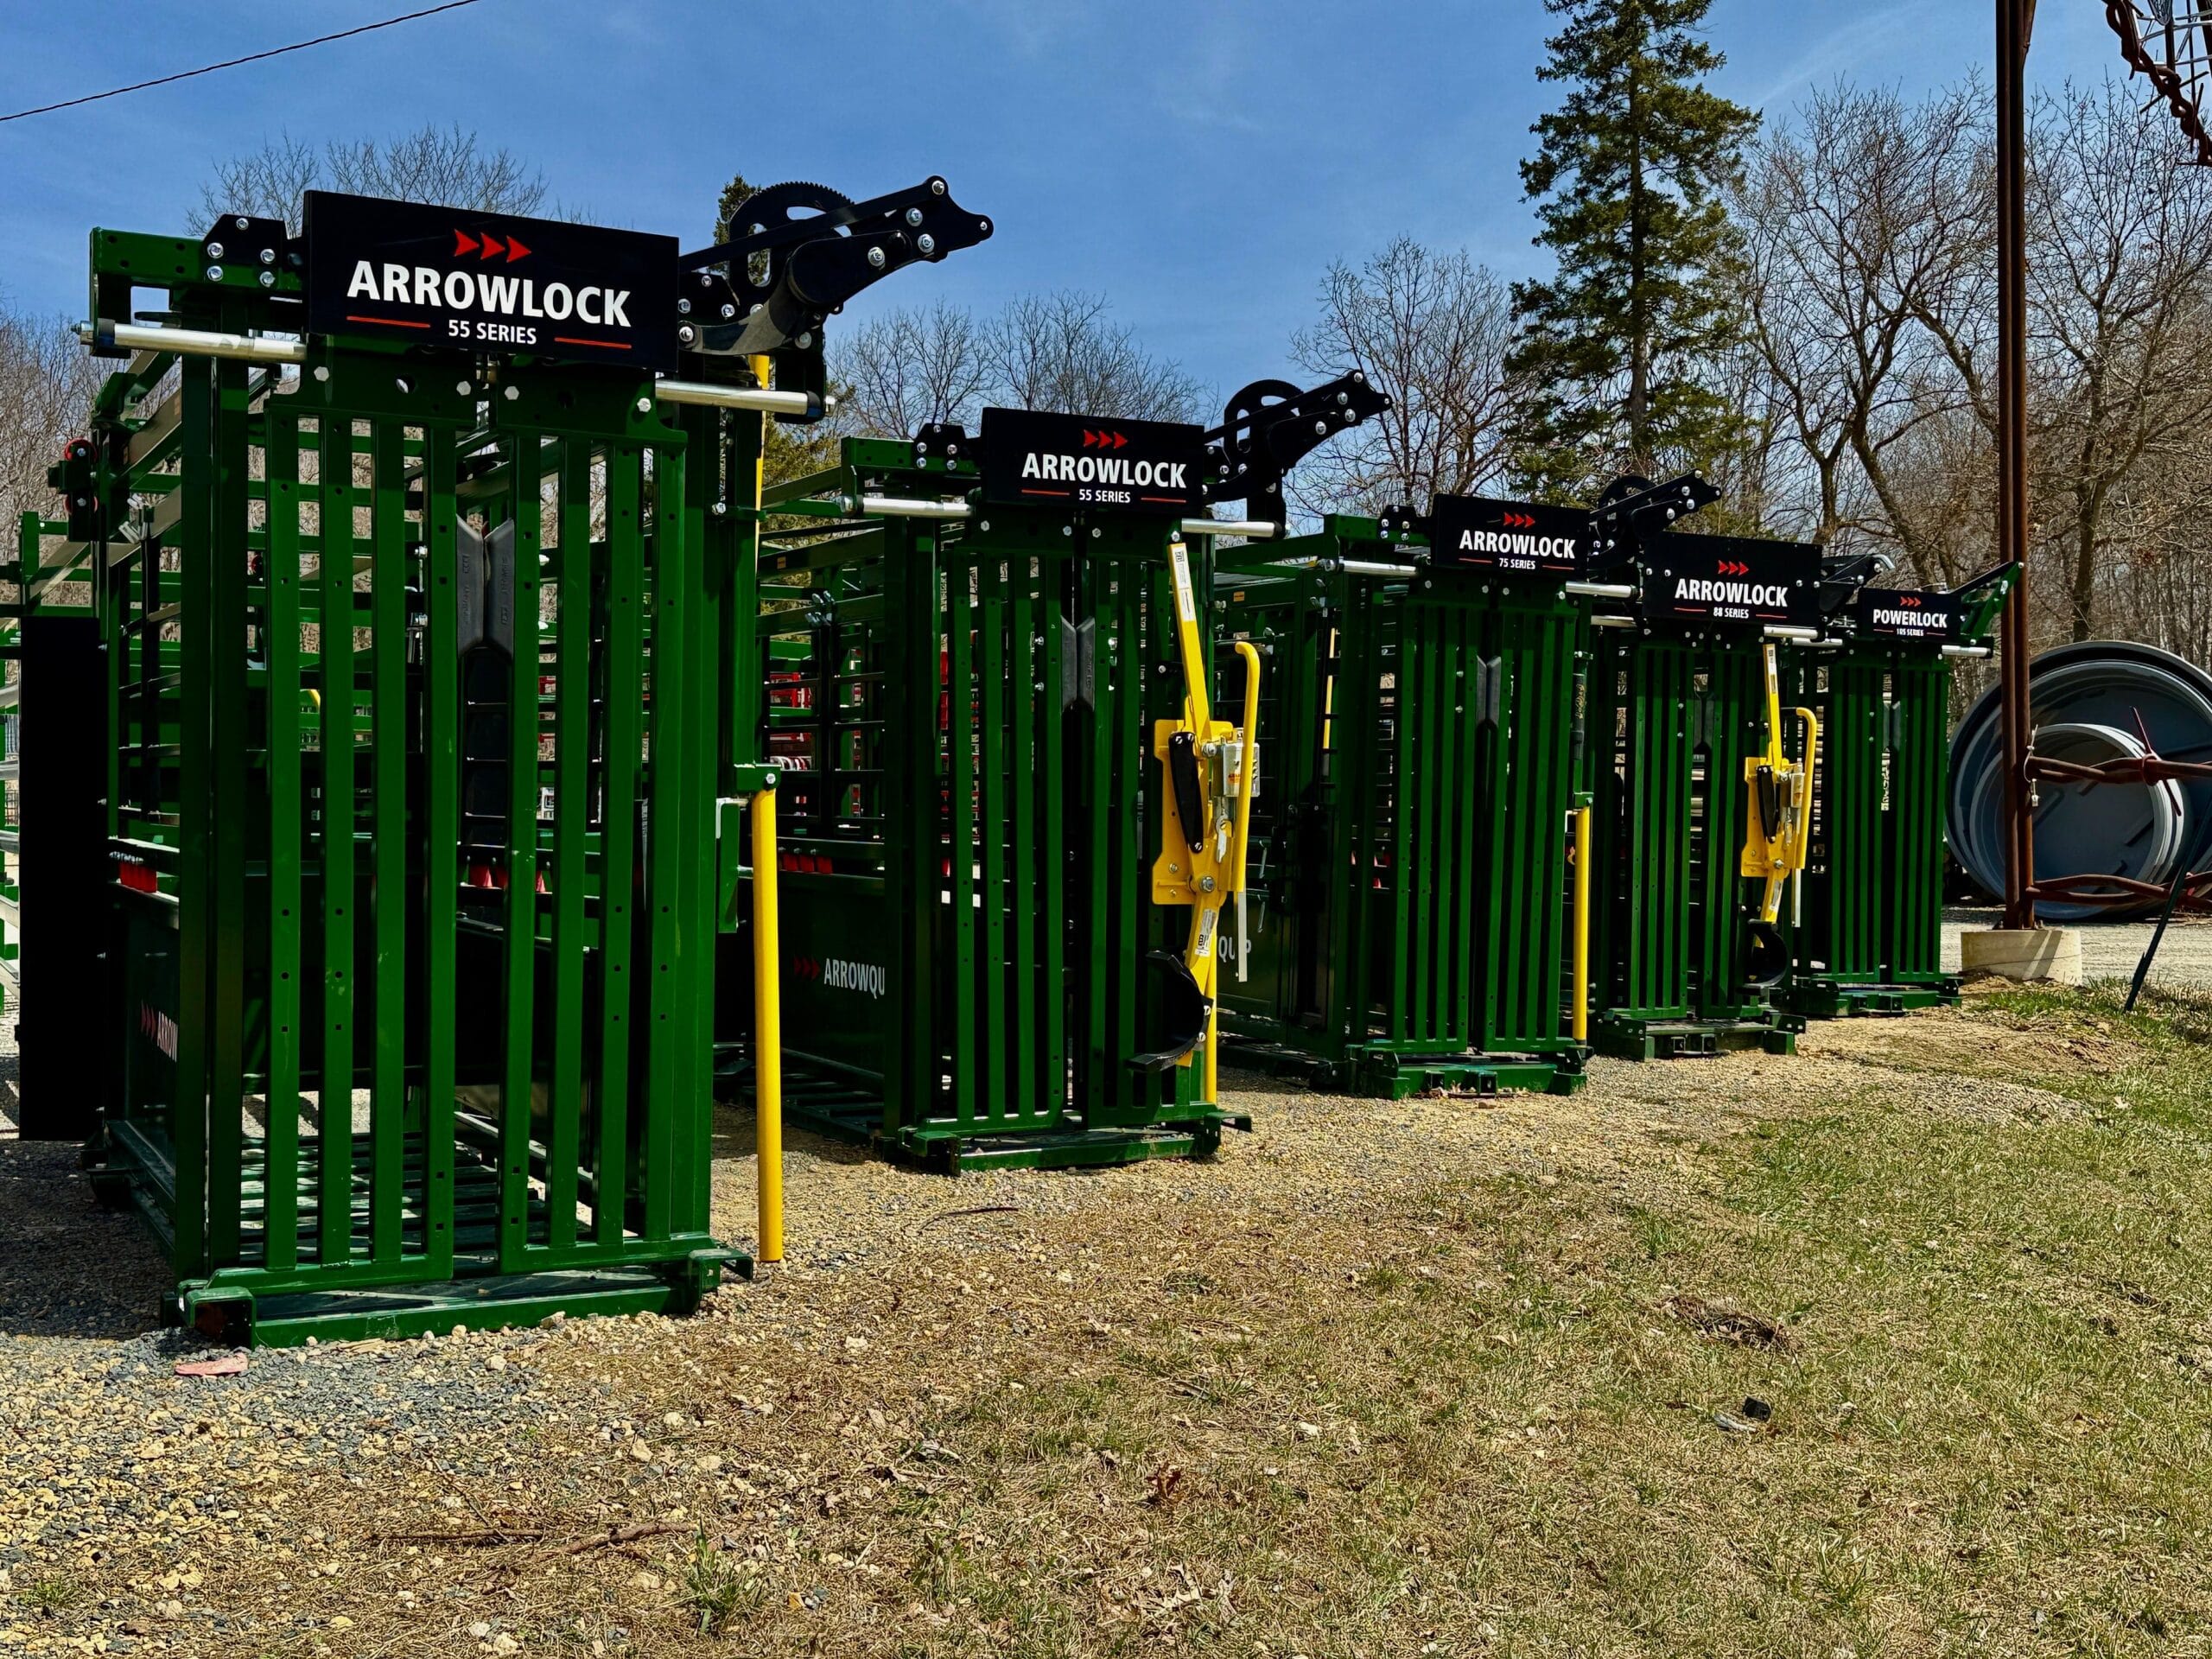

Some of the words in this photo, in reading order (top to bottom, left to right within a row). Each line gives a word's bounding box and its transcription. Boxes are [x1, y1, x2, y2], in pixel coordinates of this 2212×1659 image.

[346, 260, 632, 327] ARROWLOCK
[448, 319, 470, 338] 55
[476, 321, 537, 345] SERIES
[1021, 452, 1187, 488] ARROWLOCK
[1078, 489, 1092, 501] 55
[1095, 490, 1131, 504] SERIES
[1459, 530, 1576, 559] ARROWLOCK
[1498, 557, 1509, 568] 75
[1510, 558, 1536, 569] SERIES
[1675, 578, 1789, 607] ARROWLOCK
[1713, 607, 1723, 617] 88
[1724, 607, 1750, 619] SERIES
[1872, 608, 1948, 628] POWERLOCK
[1906, 628, 1924, 637] SERIES
